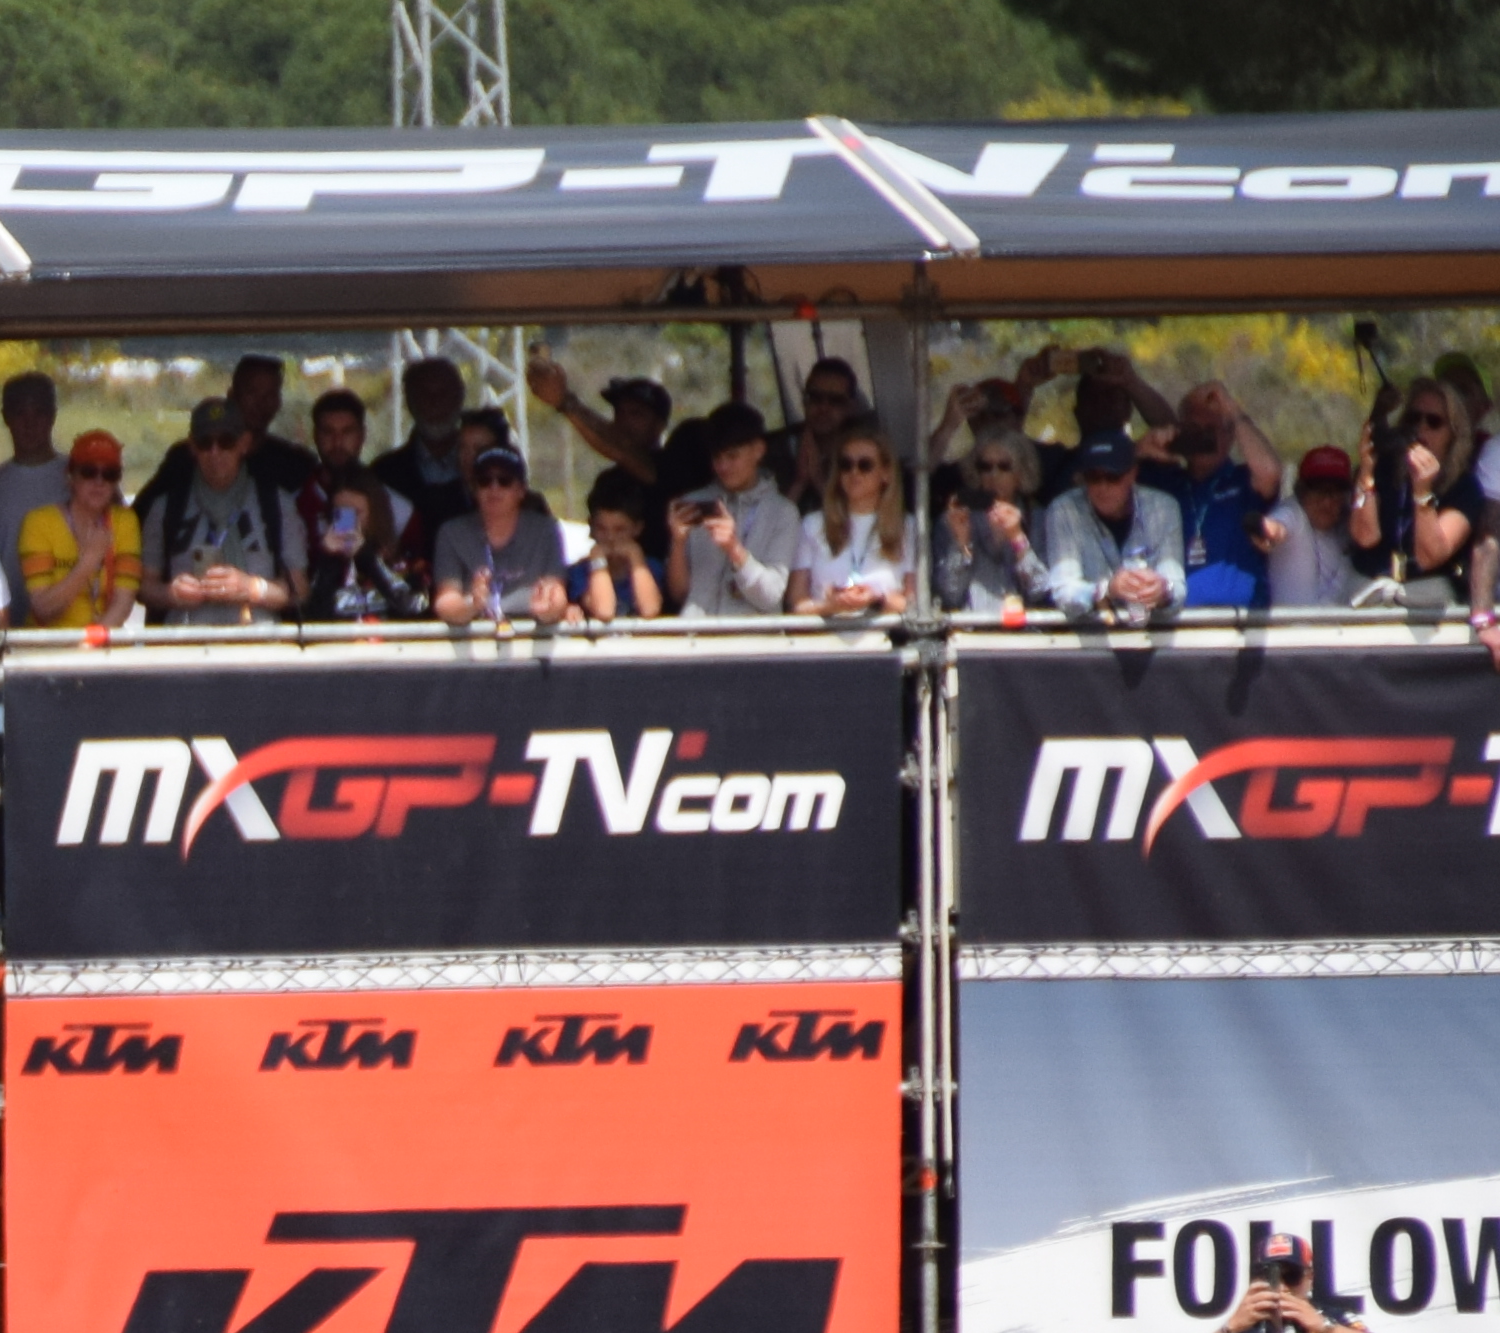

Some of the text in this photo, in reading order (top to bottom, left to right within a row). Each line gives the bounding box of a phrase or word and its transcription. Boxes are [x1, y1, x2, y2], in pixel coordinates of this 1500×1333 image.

[21, 1022, 183, 1076] KTM
[259, 1017, 418, 1071] KTM
[493, 1013, 654, 1067] KTM
[728, 1009, 887, 1063] KTM
